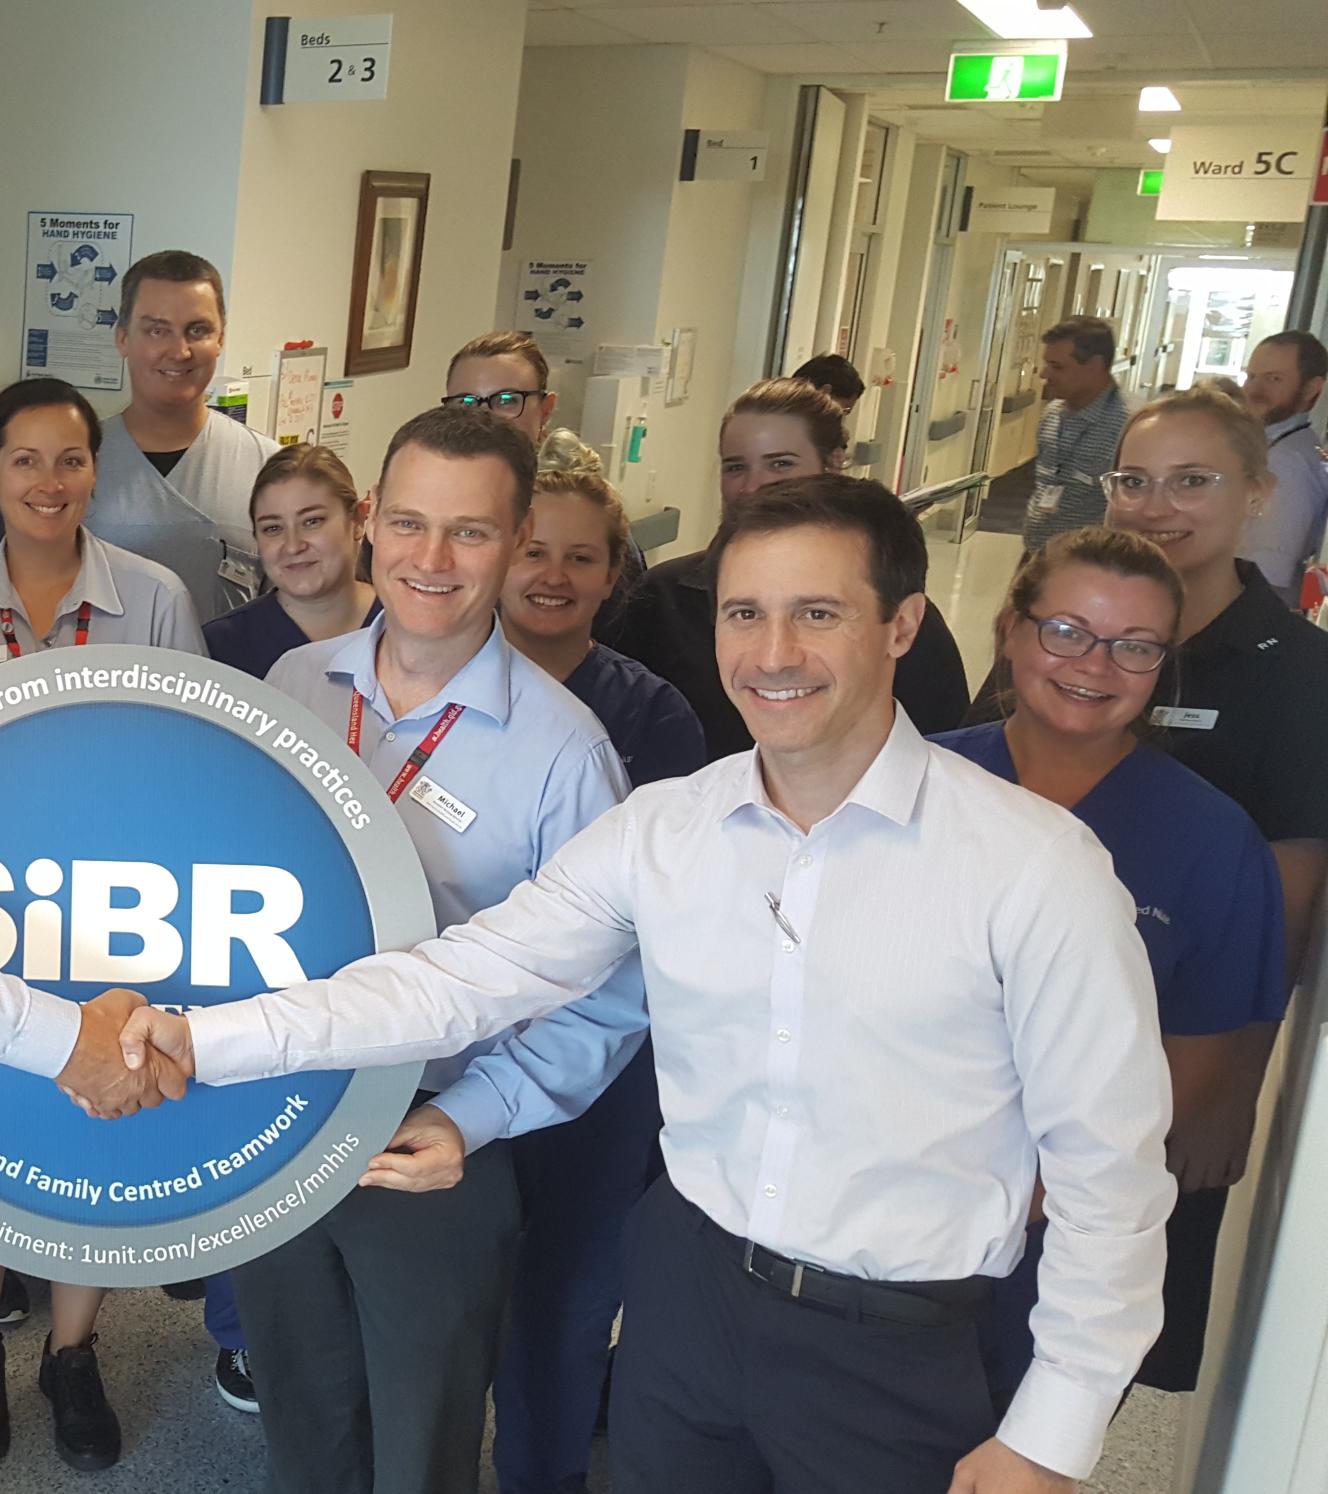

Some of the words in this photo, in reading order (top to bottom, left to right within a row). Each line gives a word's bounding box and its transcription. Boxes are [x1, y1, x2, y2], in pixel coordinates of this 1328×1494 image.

[300, 32, 331, 46] Beds
[328, 58, 343, 83] 2
[347, 64, 356, 76] &
[360, 57, 376, 82] 3
[750, 155, 758, 170] 1
[1193, 161, 1244, 175] Ward
[1253, 151, 1299, 175] 5C
[1008, 203, 1037, 212] Lounge
[40, 218, 47, 228] 5
[49, 218, 100, 229] Moments
[103, 219, 120, 229] for
[42, 229, 69, 238] HAND
[72, 230, 118, 239] HYGIENE
[1257, 638, 1278, 650] RN
[54, 664, 278, 737] interdisciplinary
[273, 727, 371, 830] practices
[437, 795, 466, 818] Michael
[25, 1166, 102, 1205] Family
[109, 1167, 203, 1202] Centred
[203, 1092, 309, 1180] Teamwork
[80, 1132, 360, 1265] 1unit.com/excellence/mnhhs
